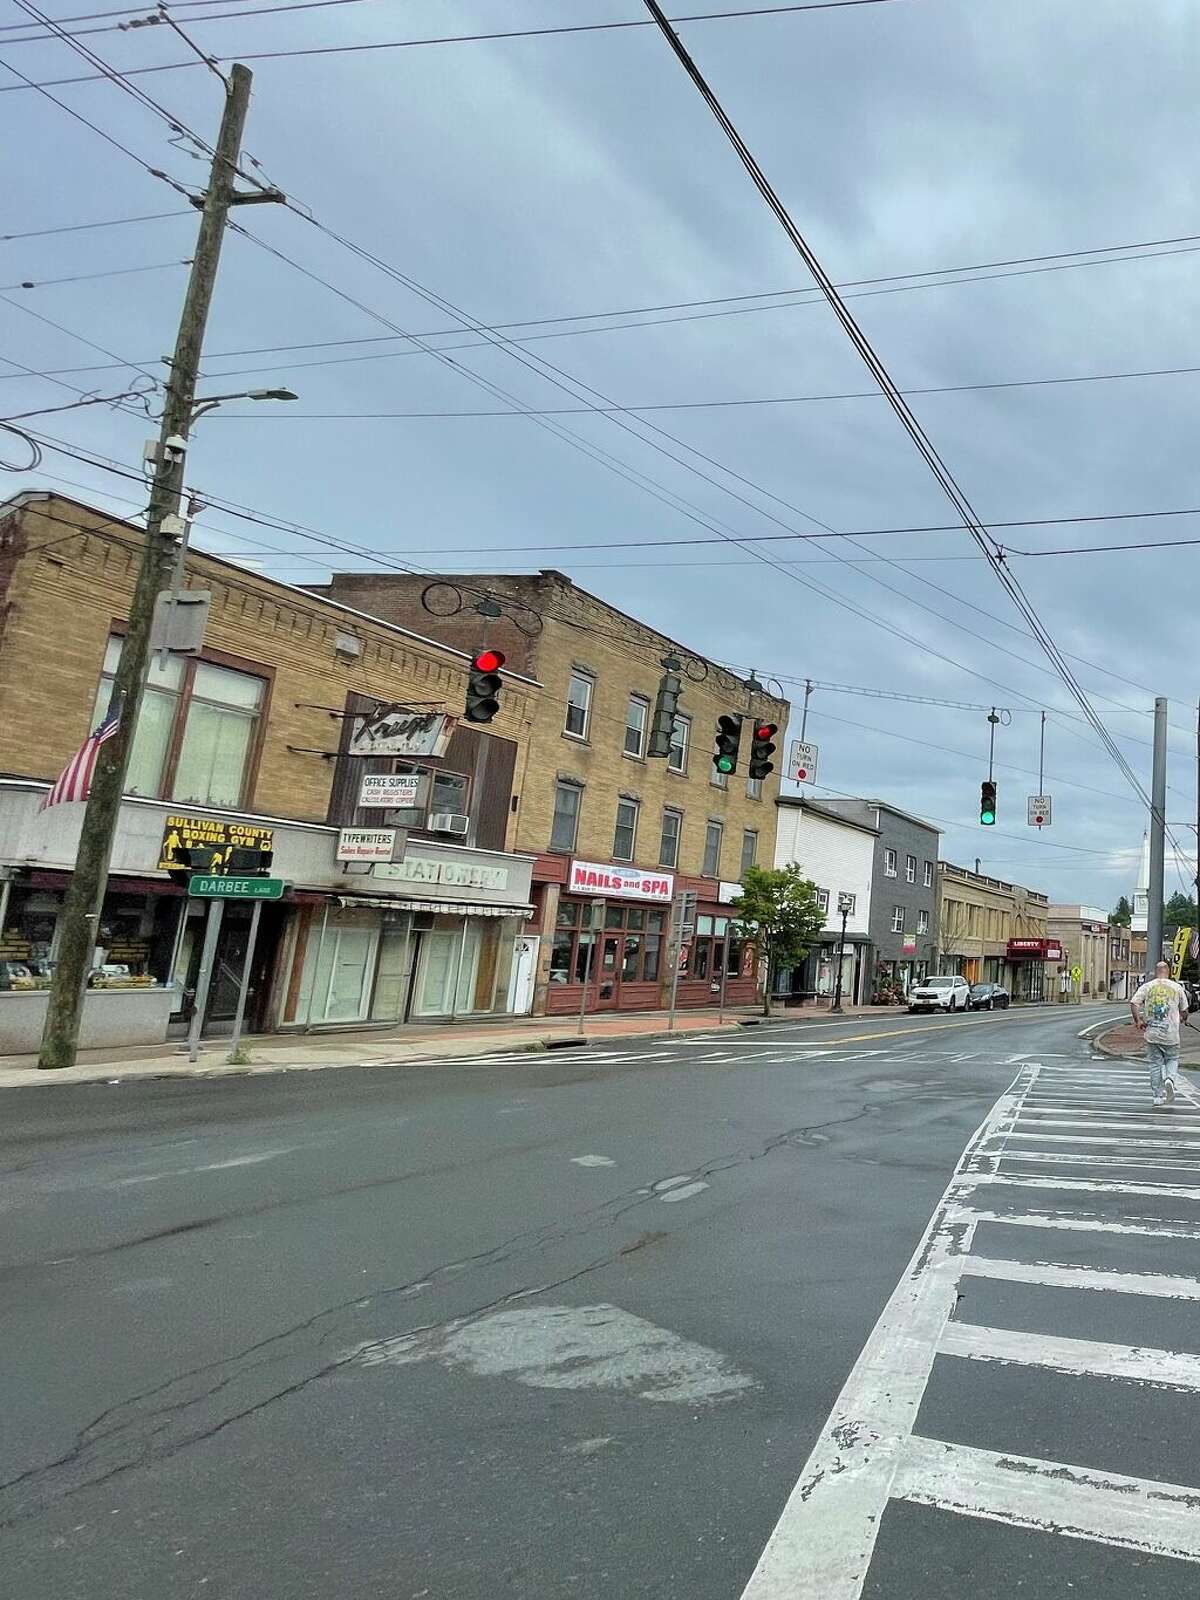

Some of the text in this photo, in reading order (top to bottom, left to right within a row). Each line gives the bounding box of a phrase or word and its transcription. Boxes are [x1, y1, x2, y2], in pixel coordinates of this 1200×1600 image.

[798, 744, 811, 754] NO
[796, 752, 812, 762] TURN
[802, 762, 814, 770] RED
[365, 777, 419, 788] OFFICE SUPPLIES
[167, 816, 273, 839] SULLIVAN COUNTY
[182, 829, 255, 847] BOXING GYM
[343, 833, 392, 844] TYPEWRITERS
[200, 880, 250, 893] DARBEE
[575, 868, 623, 890] NAILS
[623, 880, 641, 889] and
[641, 880, 669, 896] SPA
